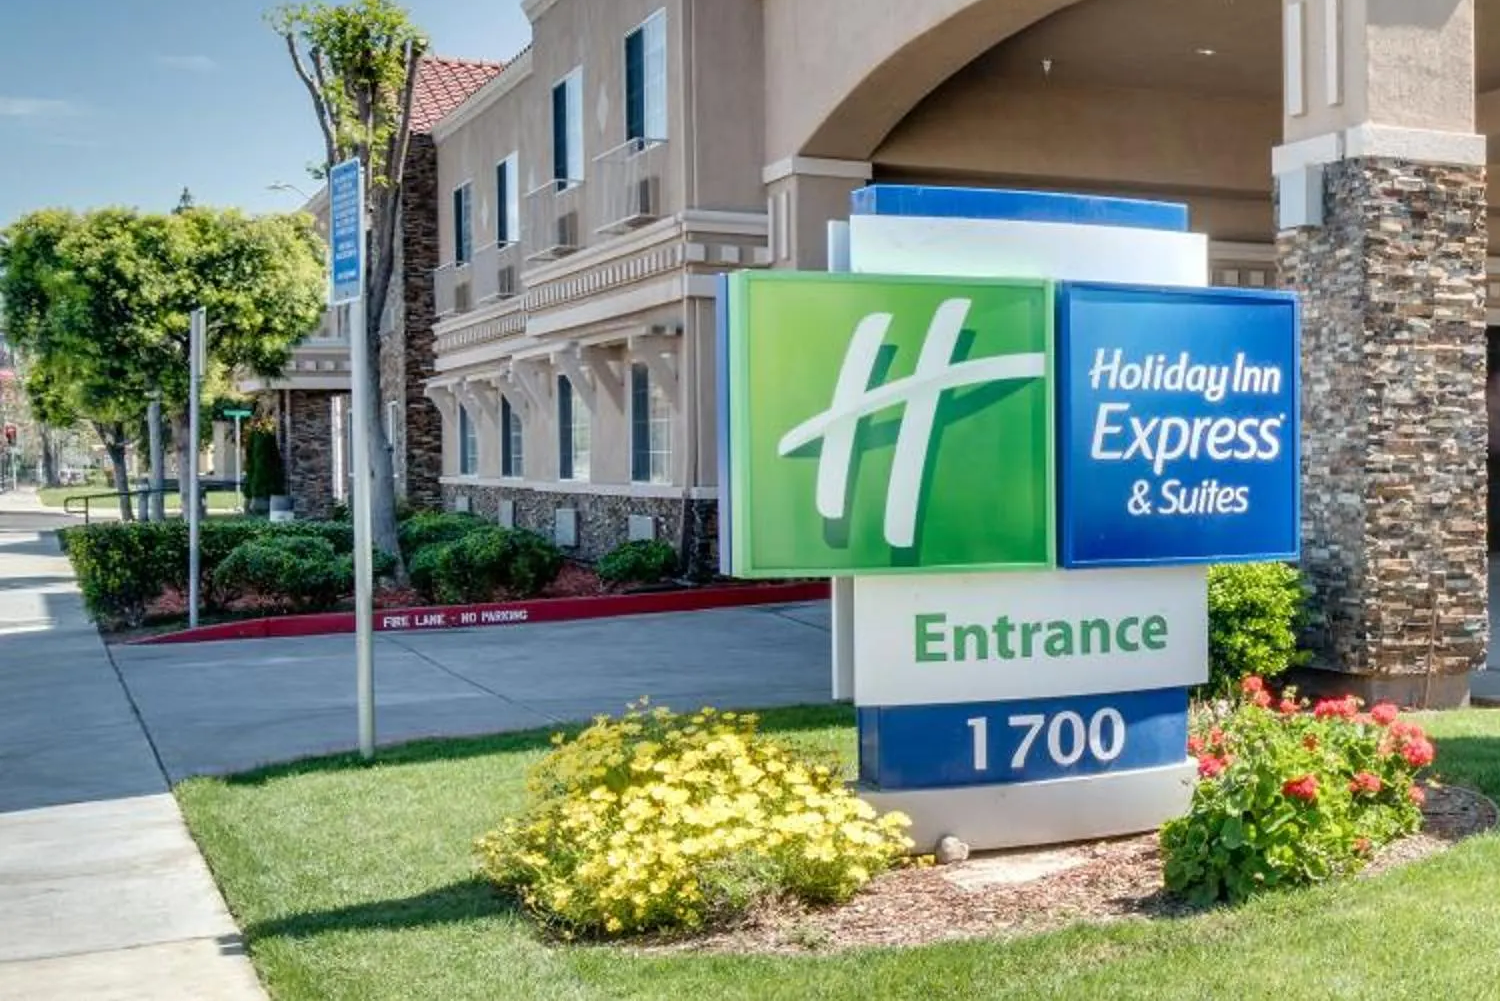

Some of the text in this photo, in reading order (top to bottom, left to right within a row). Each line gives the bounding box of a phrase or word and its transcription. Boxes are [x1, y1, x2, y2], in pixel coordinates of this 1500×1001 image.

[1089, 347, 1281, 403] Holiday Inn
[776, 298, 1045, 548] H
[1090, 402, 1283, 476] Express
[1127, 478, 1250, 515] & Suites
[383, 615, 410, 628] FIRE
[414, 613, 446, 626] LANE
[460, 612, 477, 624] NO
[481, 609, 529, 623] PARKING
[914, 612, 1169, 663] Entrance
[966, 706, 1126, 771] 1700
